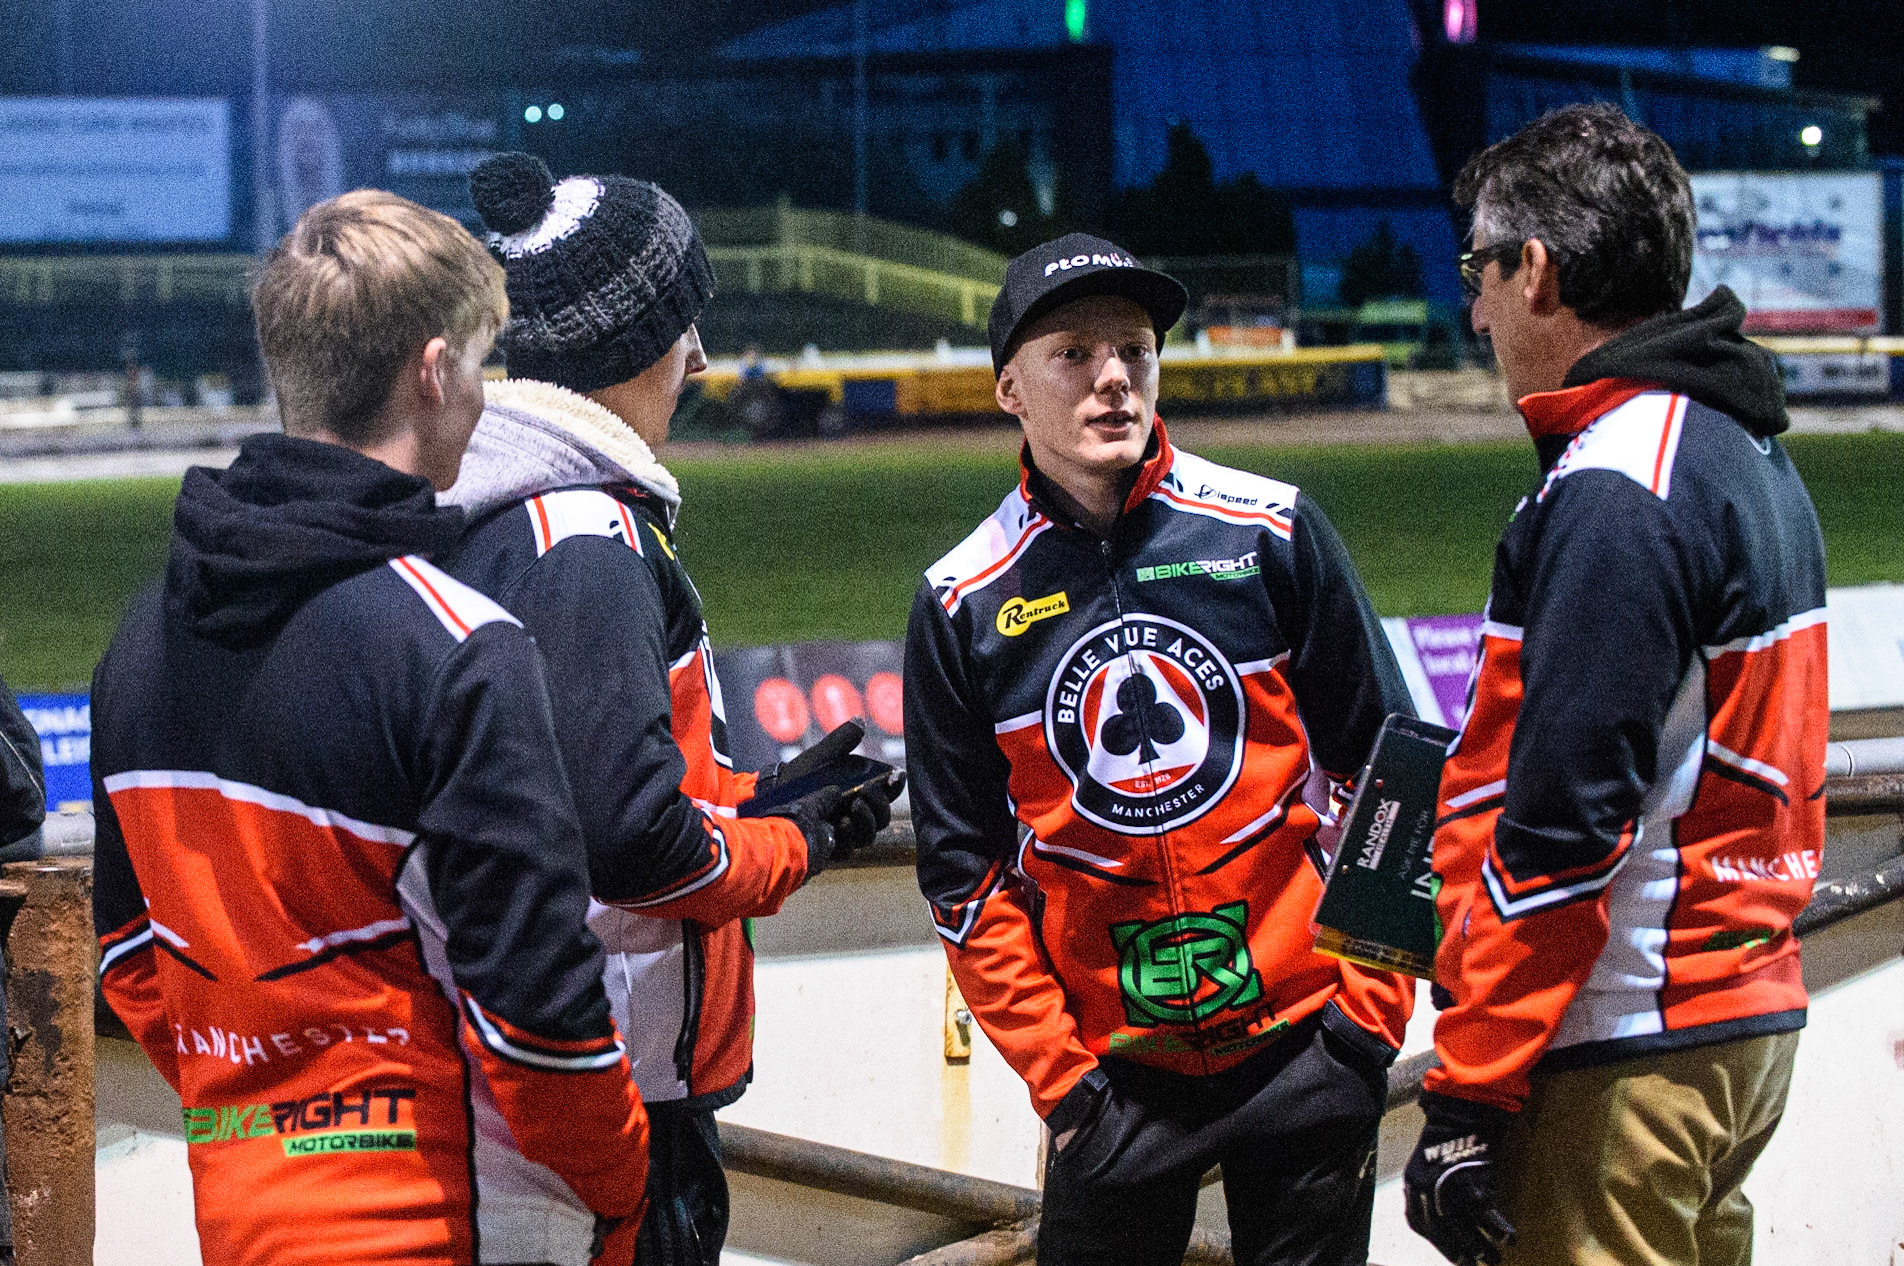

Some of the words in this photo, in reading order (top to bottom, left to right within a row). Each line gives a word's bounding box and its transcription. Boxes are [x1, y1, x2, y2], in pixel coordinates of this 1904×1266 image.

[1002, 604, 1066, 629] Rentruck
[1057, 648, 1101, 723] BELLE
[1104, 627, 1158, 654] VUE
[1166, 637, 1225, 691] ACES
[1112, 783, 1205, 818] MANCHESTER
[1356, 797, 1393, 869] RANDOX
[1710, 849, 1824, 882] MANCHE
